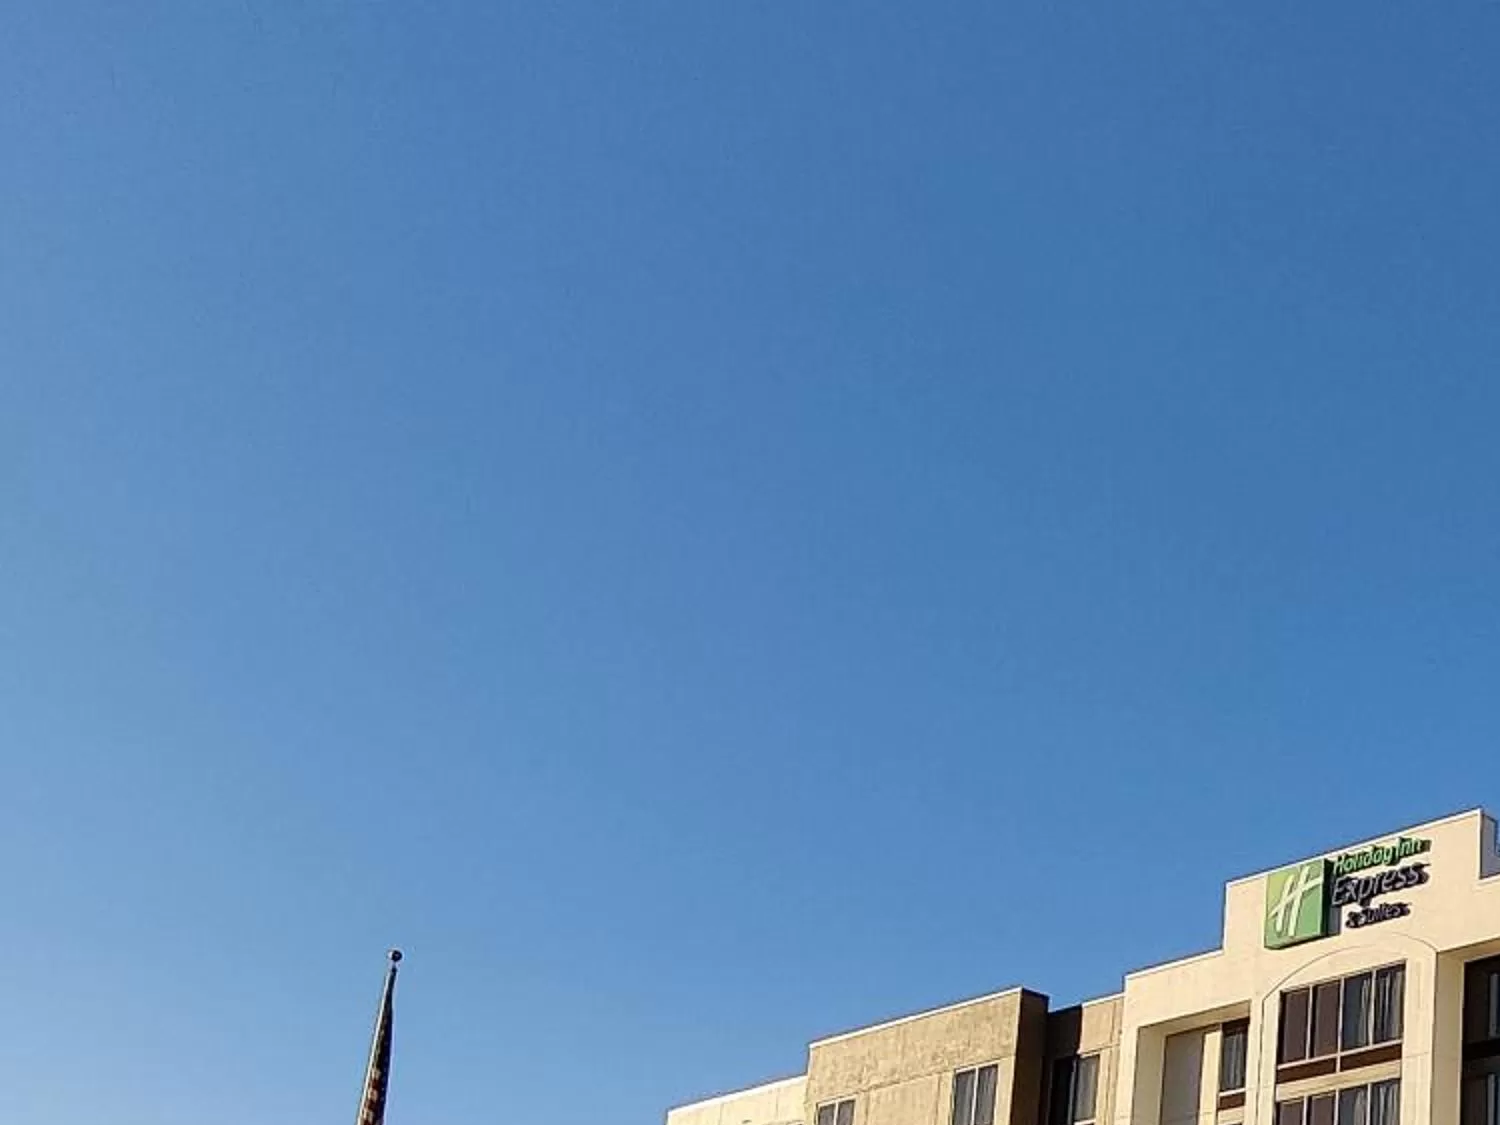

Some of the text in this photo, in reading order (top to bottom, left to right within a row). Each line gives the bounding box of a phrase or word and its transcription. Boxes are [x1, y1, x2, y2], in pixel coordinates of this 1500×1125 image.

[1333, 837, 1422, 875] Holiday Inn
[1331, 866, 1421, 905] Express
[1358, 904, 1403, 925] Suites
